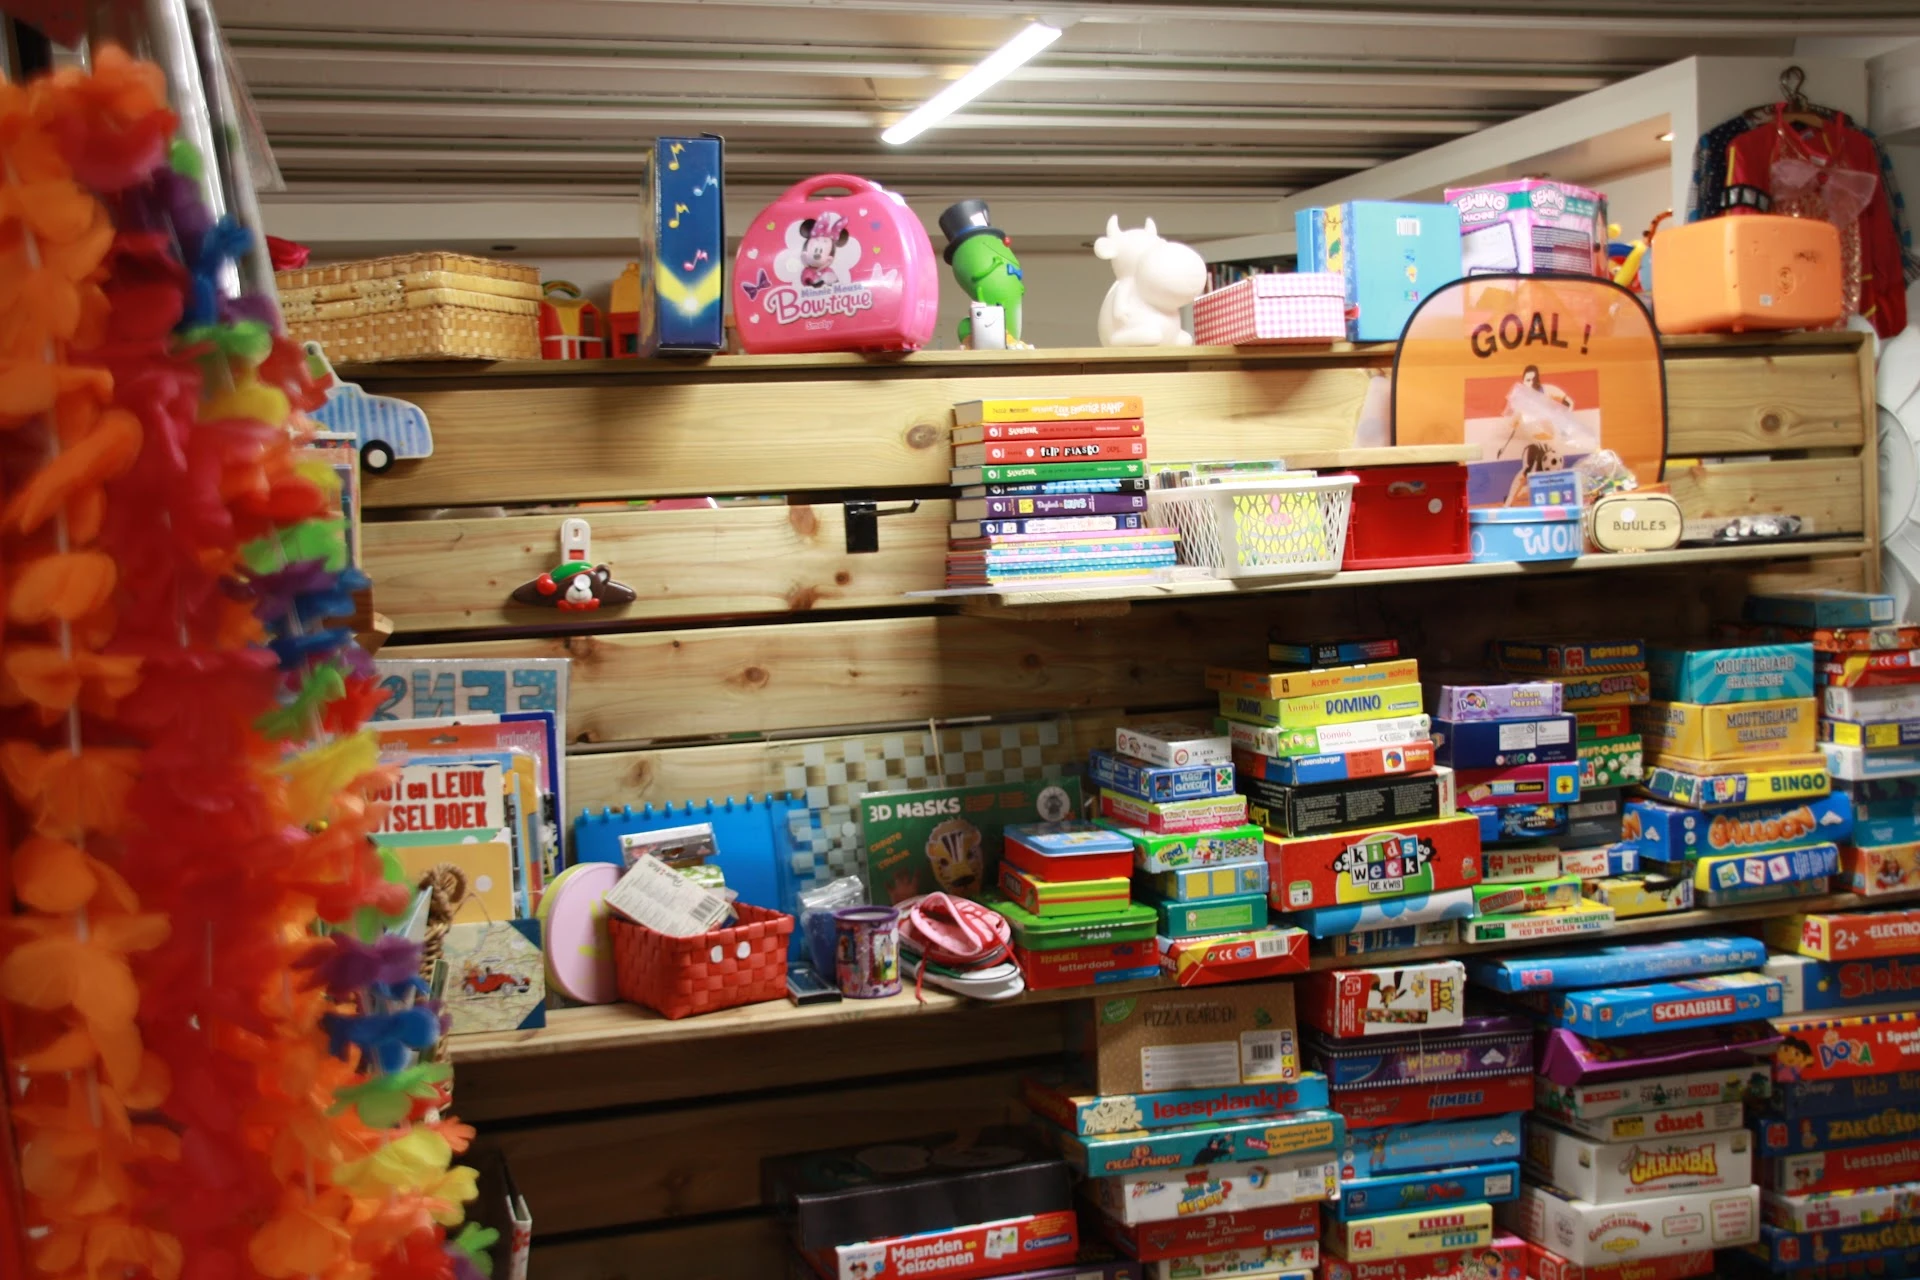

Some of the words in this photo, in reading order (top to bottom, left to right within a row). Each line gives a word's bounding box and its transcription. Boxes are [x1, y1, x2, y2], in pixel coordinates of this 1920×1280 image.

[1454, 191, 1506, 213] EWING
[1530, 189, 1565, 211] SEWING
[801, 287, 831, 298] Minnie
[1471, 311, 1569, 359] GOAL
[1579, 323, 1592, 355] !
[1040, 446, 1060, 457] FLIP
[1064, 444, 1100, 456] FIASCO
[1612, 520, 1667, 532] BOULES
[1715, 656, 1796, 675] MOUTHGUARD
[1311, 678, 1331, 688] kom
[1727, 674, 1784, 690] CHALLENGE
[1510, 698, 1544, 707] Puzzels
[1512, 690, 1540, 699] Reken
[1286, 699, 1320, 713] Animals
[1325, 694, 1381, 715] DOMINO
[1727, 708, 1798, 729] MOUTHGUARD
[1738, 727, 1788, 743] CHALLENGE
[1299, 755, 1341, 767] Ravensburger
[407, 782, 428, 799] en
[431, 770, 486, 800] LEUK
[1771, 774, 1827, 792] BINGO
[869, 804, 892, 823] 3D
[1709, 806, 1816, 848] BALLOON
[1352, 838, 1416, 863] kids
[1507, 854, 1521, 865] het
[1523, 853, 1557, 864] Verkeer
[1354, 859, 1416, 882] week
[1513, 867, 1524, 875] en
[1370, 880, 1381, 891] DE
[1534, 927, 1544, 935] DE
[1546, 924, 1576, 934] MOULIN
[1582, 921, 1601, 930] MILL
[1834, 929, 1860, 951] 2+
[1058, 960, 1116, 972] letterdoos
[1728, 951, 1741, 960] de
[1742, 950, 1757, 963] jeu
[1520, 969, 1553, 986] K3
[1439, 977, 1455, 1013] TOY
[1144, 1009, 1182, 1027] PIZZA
[1186, 1006, 1236, 1024] GARDEN
[1655, 997, 1733, 1020] SCRABBLE
[1818, 1040, 1874, 1070] DORA
[1153, 1086, 1299, 1120] leesplankje
[1655, 1110, 1705, 1133] duet
[1142, 1153, 1181, 1166] MINDY
[1630, 1143, 1718, 1185] CARAMBA
[1843, 1148, 1920, 1170] Leesspelle
[1206, 1216, 1216, 1227] 3
[1229, 1214, 1235, 1226] 1
[891, 1238, 963, 1262] Maanden
[965, 1239, 977, 1250] en
[897, 1252, 975, 1276] Seizoenen
[1204, 1263, 1226, 1275] Bert
[1357, 1259, 1406, 1278] Dora's
